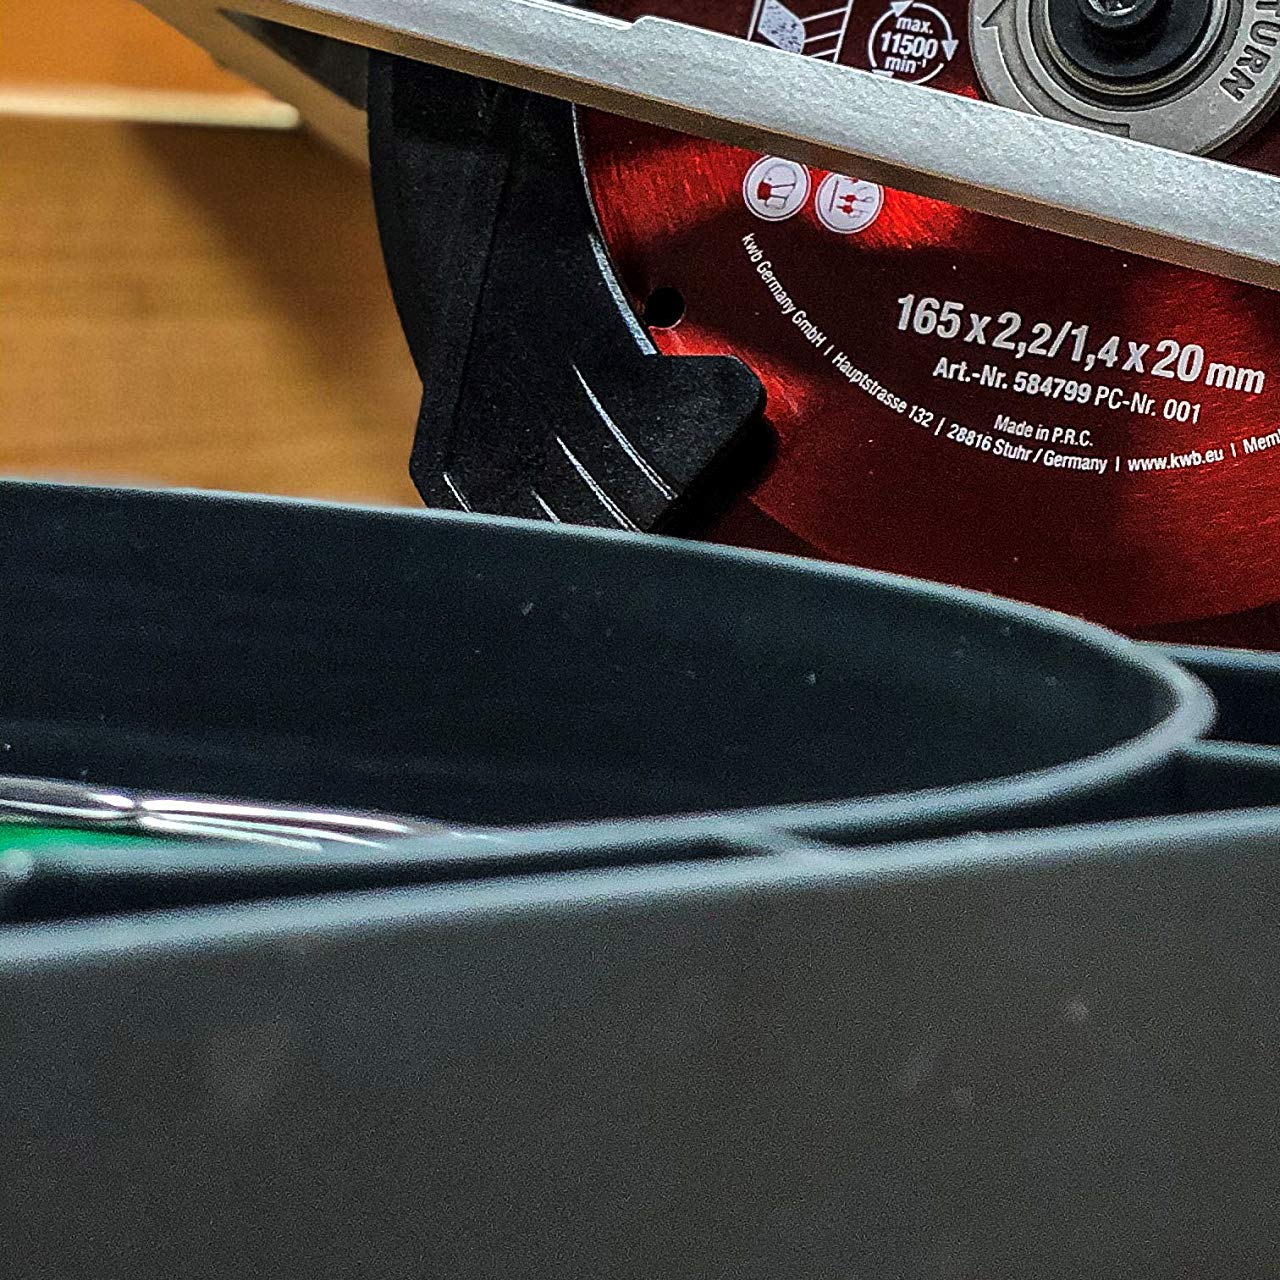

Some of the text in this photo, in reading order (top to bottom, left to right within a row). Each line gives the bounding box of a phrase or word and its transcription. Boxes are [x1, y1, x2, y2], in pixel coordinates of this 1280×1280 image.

[881, 31, 939, 60] 11500
[896, 16, 934, 34] max.
[741, 232, 763, 263] kwb
[755, 259, 796, 316] Germany
[791, 309, 827, 349] GmbH
[831, 351, 908, 414] Hauptstrasse
[907, 405, 935, 428] 132
[945, 422, 992, 452] 28816
[993, 437, 1034, 462] Stuhr
[1042, 449, 1109, 475] Germany
[1127, 448, 1226, 472] www.kwb.eu
[897, 293, 964, 339] 165
[1151, 340, 1205, 382] 20
[1205, 361, 1266, 394] mm
[932, 357, 1202, 425] Art.-Nr. 584799 PC-Nr. 001
[993, 414, 1094, 448] Made in P.R.C.
